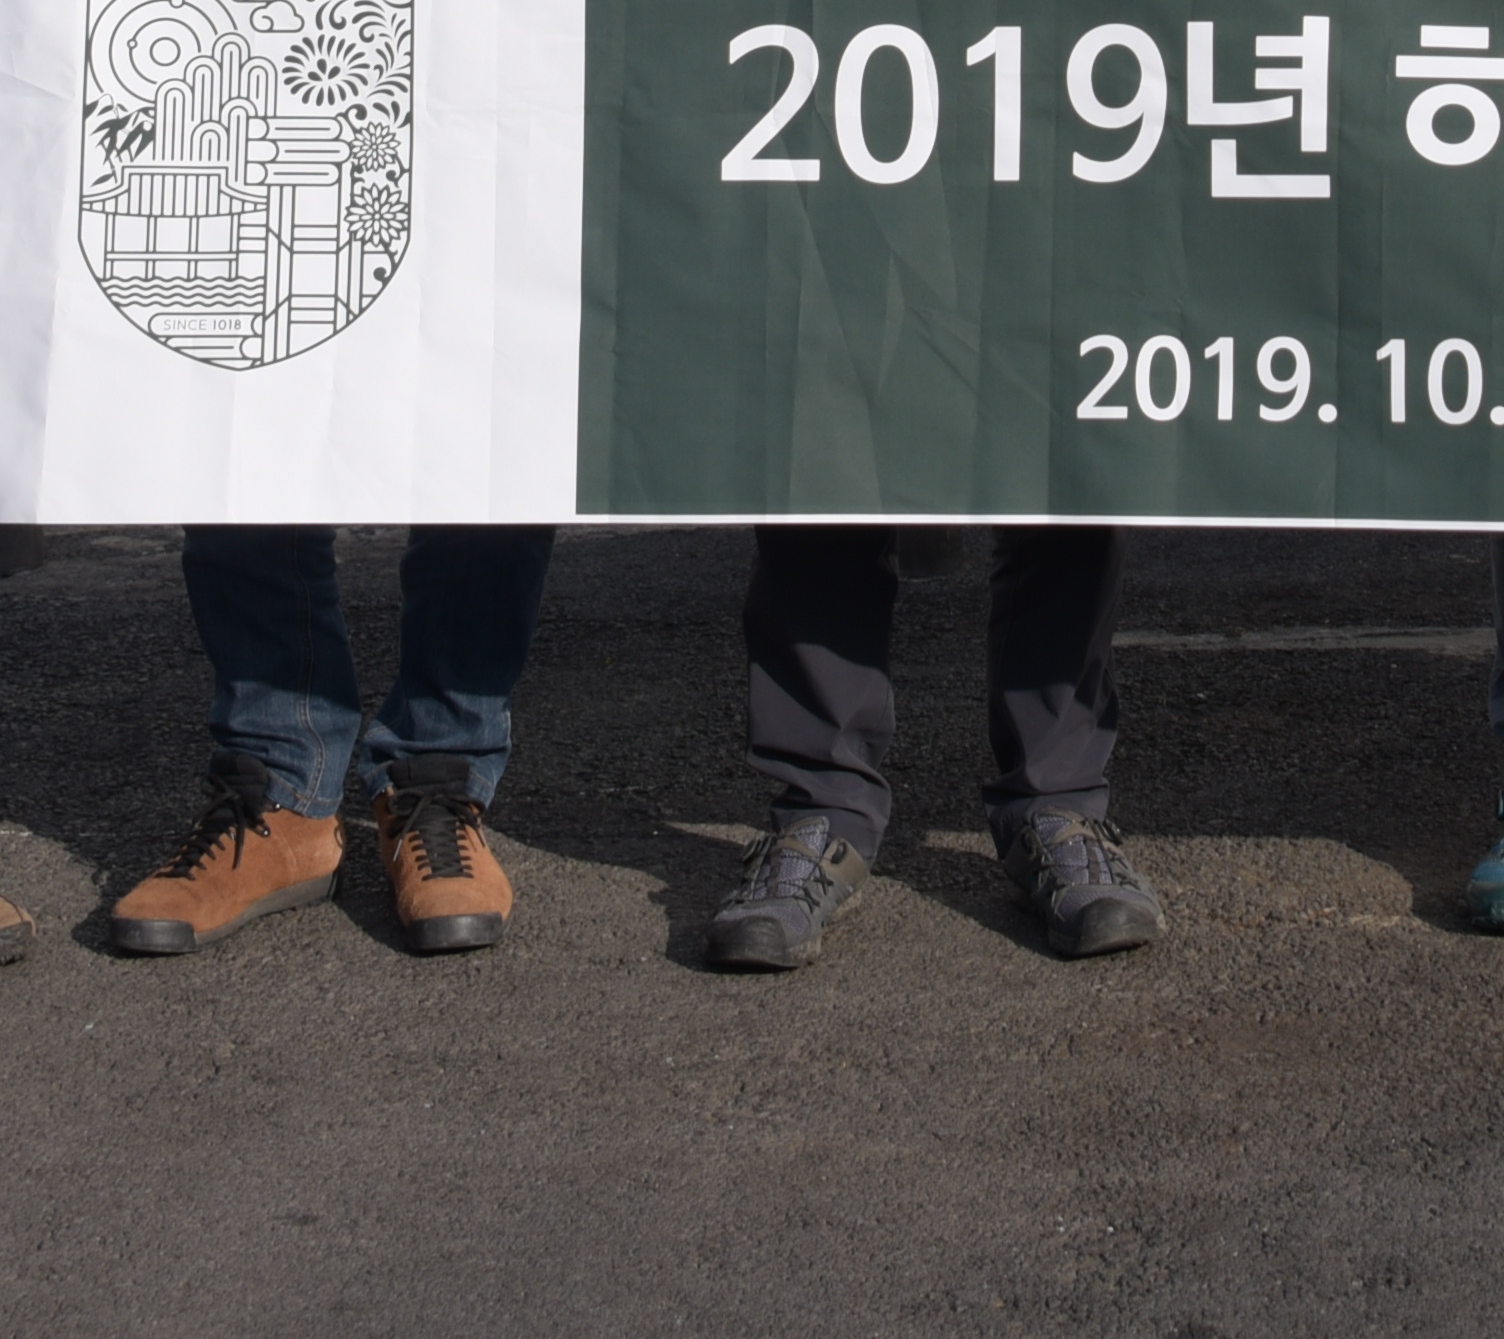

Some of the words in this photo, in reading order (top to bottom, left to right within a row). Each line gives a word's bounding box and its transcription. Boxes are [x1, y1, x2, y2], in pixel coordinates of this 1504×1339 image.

[720, 15, 1331, 198] 2019년
[163, 319, 207, 331] SINCE
[213, 319, 242, 331] 1018
[1076, 334, 1338, 423] 2019.
